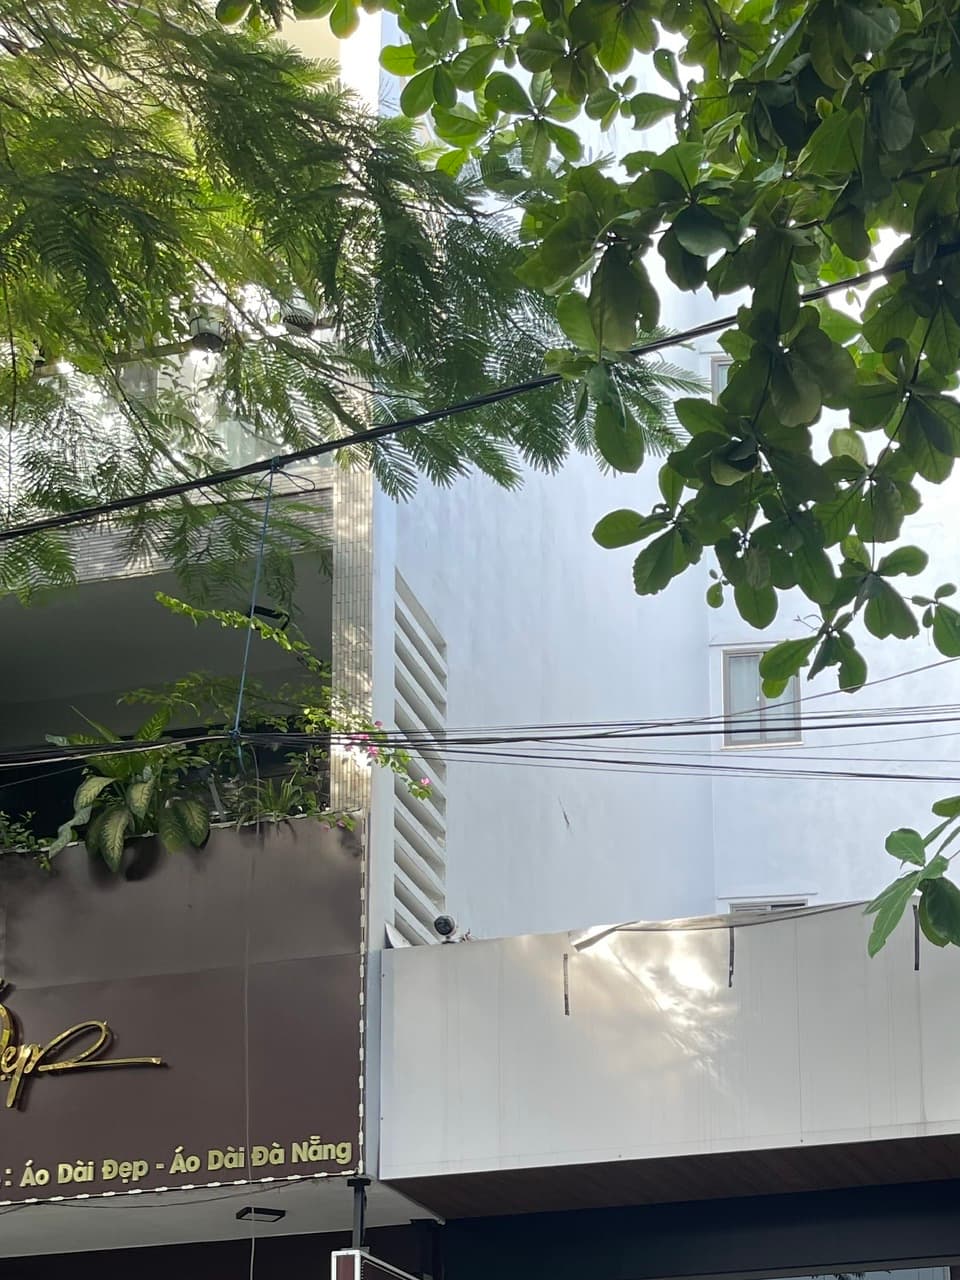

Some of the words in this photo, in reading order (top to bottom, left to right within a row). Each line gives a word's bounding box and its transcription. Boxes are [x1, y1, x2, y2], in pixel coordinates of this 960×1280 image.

[20, 1160, 50, 1187] Áo
[57, 1161, 95, 1184] Dài
[102, 1158, 149, 1184] Đẹp
[169, 1146, 201, 1174] Áo
[207, 1146, 245, 1171] Dài
[251, 1142, 285, 1167] Đà
[291, 1136, 353, 1165] Nẵng
